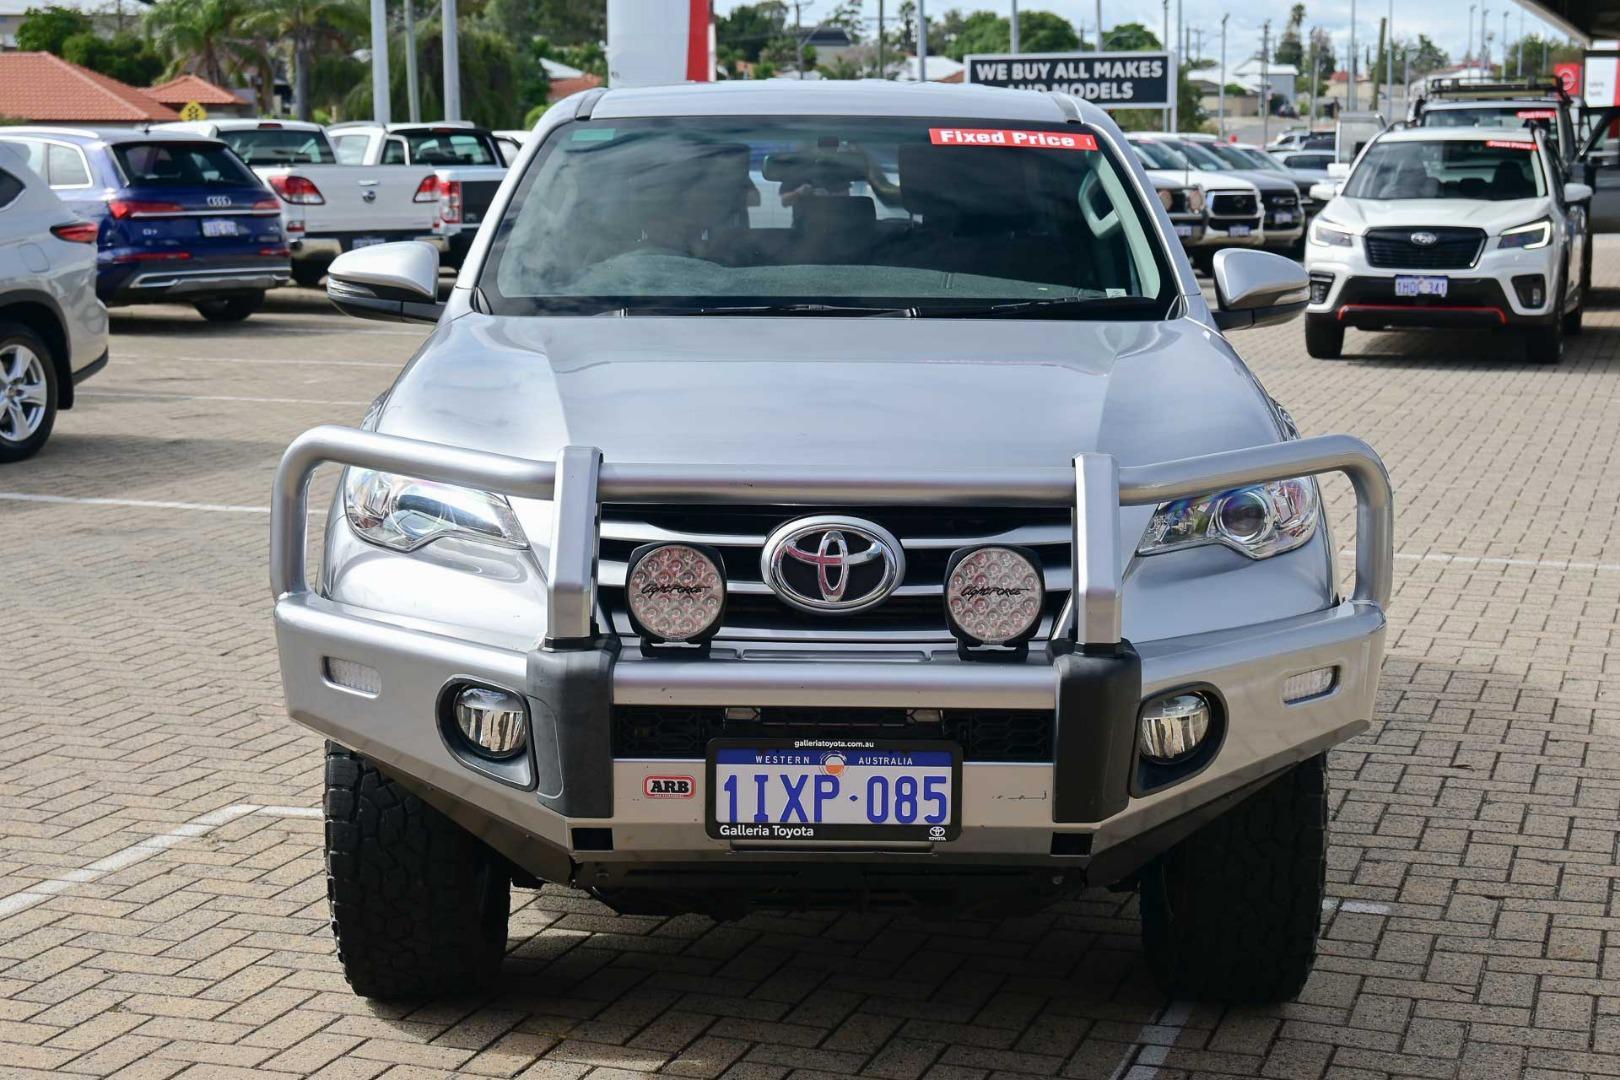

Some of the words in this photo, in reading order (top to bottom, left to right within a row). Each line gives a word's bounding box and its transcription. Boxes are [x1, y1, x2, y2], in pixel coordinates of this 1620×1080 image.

[976, 64, 1008, 81] WE
[1012, 62, 1051, 80] BUY
[1054, 61, 1089, 79] ALL
[1094, 60, 1163, 78] MAKES
[939, 130, 1006, 144] Fixed
[1011, 132, 1075, 146] Price
[794, 739, 875, 748] galleriatoyota.com.au
[755, 755, 810, 764] WESTERN
[858, 757, 913, 766] AUSTRALIA
[650, 780, 690, 794] ARB
[719, 825, 770, 837] Galleria
[772, 825, 814, 840] Toyota
